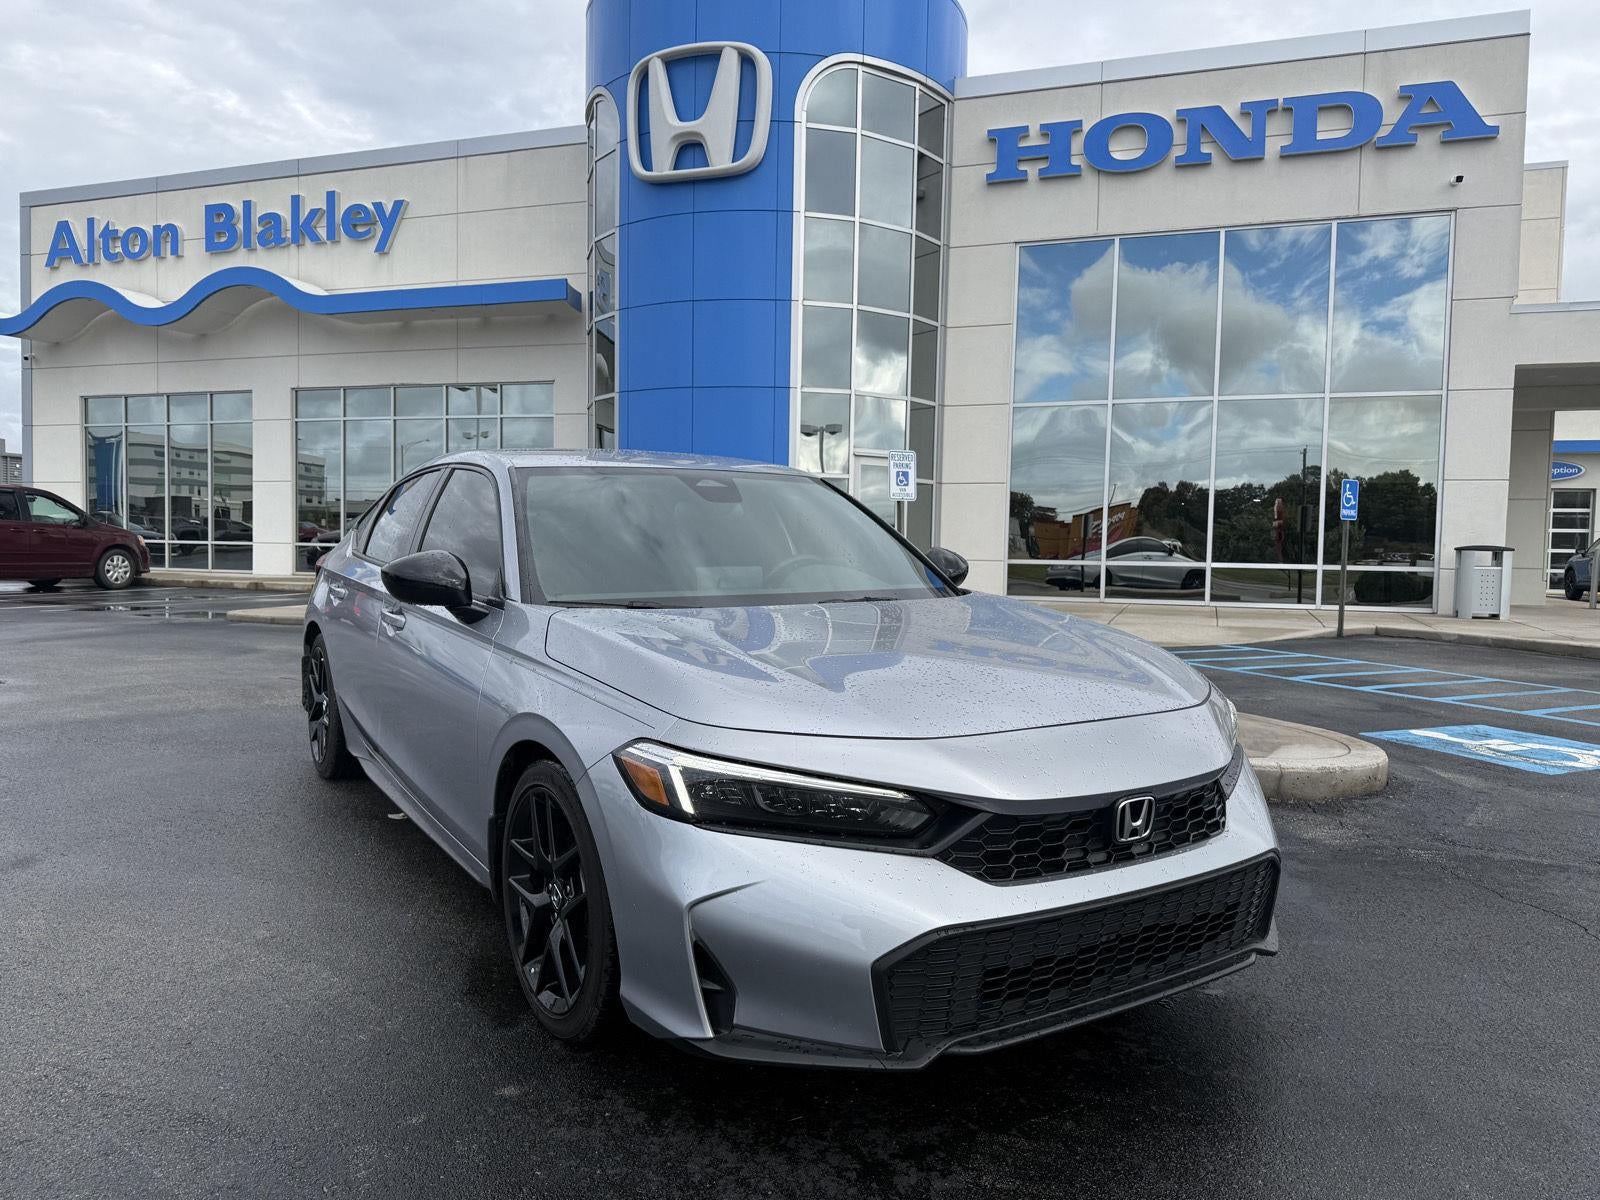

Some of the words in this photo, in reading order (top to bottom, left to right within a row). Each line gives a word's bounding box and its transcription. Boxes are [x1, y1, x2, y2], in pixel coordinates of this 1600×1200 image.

[986, 80, 1500, 184] HONDA
[45, 217, 180, 268] Alton
[204, 190, 407, 255] Blakley
[891, 453, 914, 462] RESERVED
[893, 462, 912, 470] PARKING
[1341, 508, 1356, 516] PARKING
